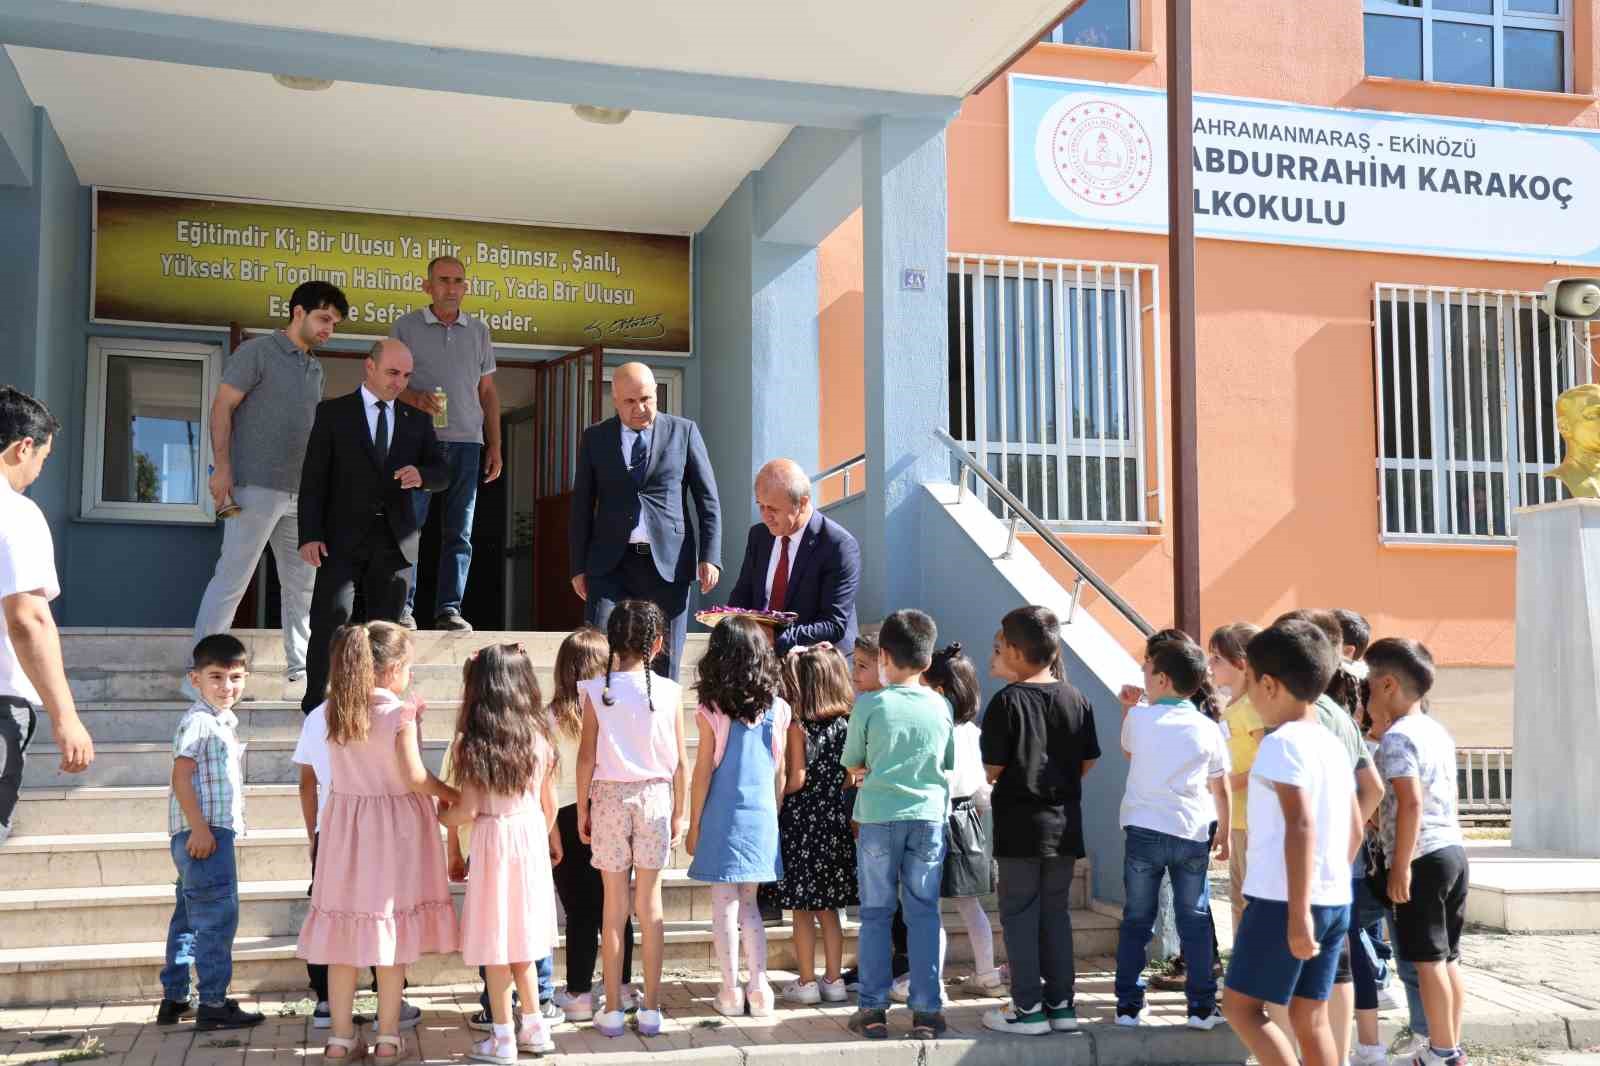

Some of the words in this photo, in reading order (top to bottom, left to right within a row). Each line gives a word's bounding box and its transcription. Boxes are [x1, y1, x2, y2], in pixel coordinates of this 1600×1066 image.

[1193, 117, 1371, 153] AHRAMANMARAŞ
[1390, 134, 1476, 159] EKİNÖZÜ
[1193, 188, 1346, 226] LKOKULU
[1418, 166, 1574, 210] KARAKOÇ
[176, 220, 268, 248] Eğitimdir
[275, 227, 301, 252] Ki;
[307, 229, 336, 251] Bir
[341, 232, 395, 257] Ulusu
[400, 237, 421, 258] Ya
[428, 238, 462, 258] Hür
[476, 241, 558, 269] Bağımsız
[572, 250, 622, 276] Şanlı,
[160, 253, 234, 281] Yüksek
[240, 260, 268, 282] Bir
[353, 267, 423, 291] Halinde
[463, 275, 499, 301] atır,
[504, 276, 548, 300] Yada
[553, 280, 578, 302] Bir
[584, 283, 635, 305] Ulusu
